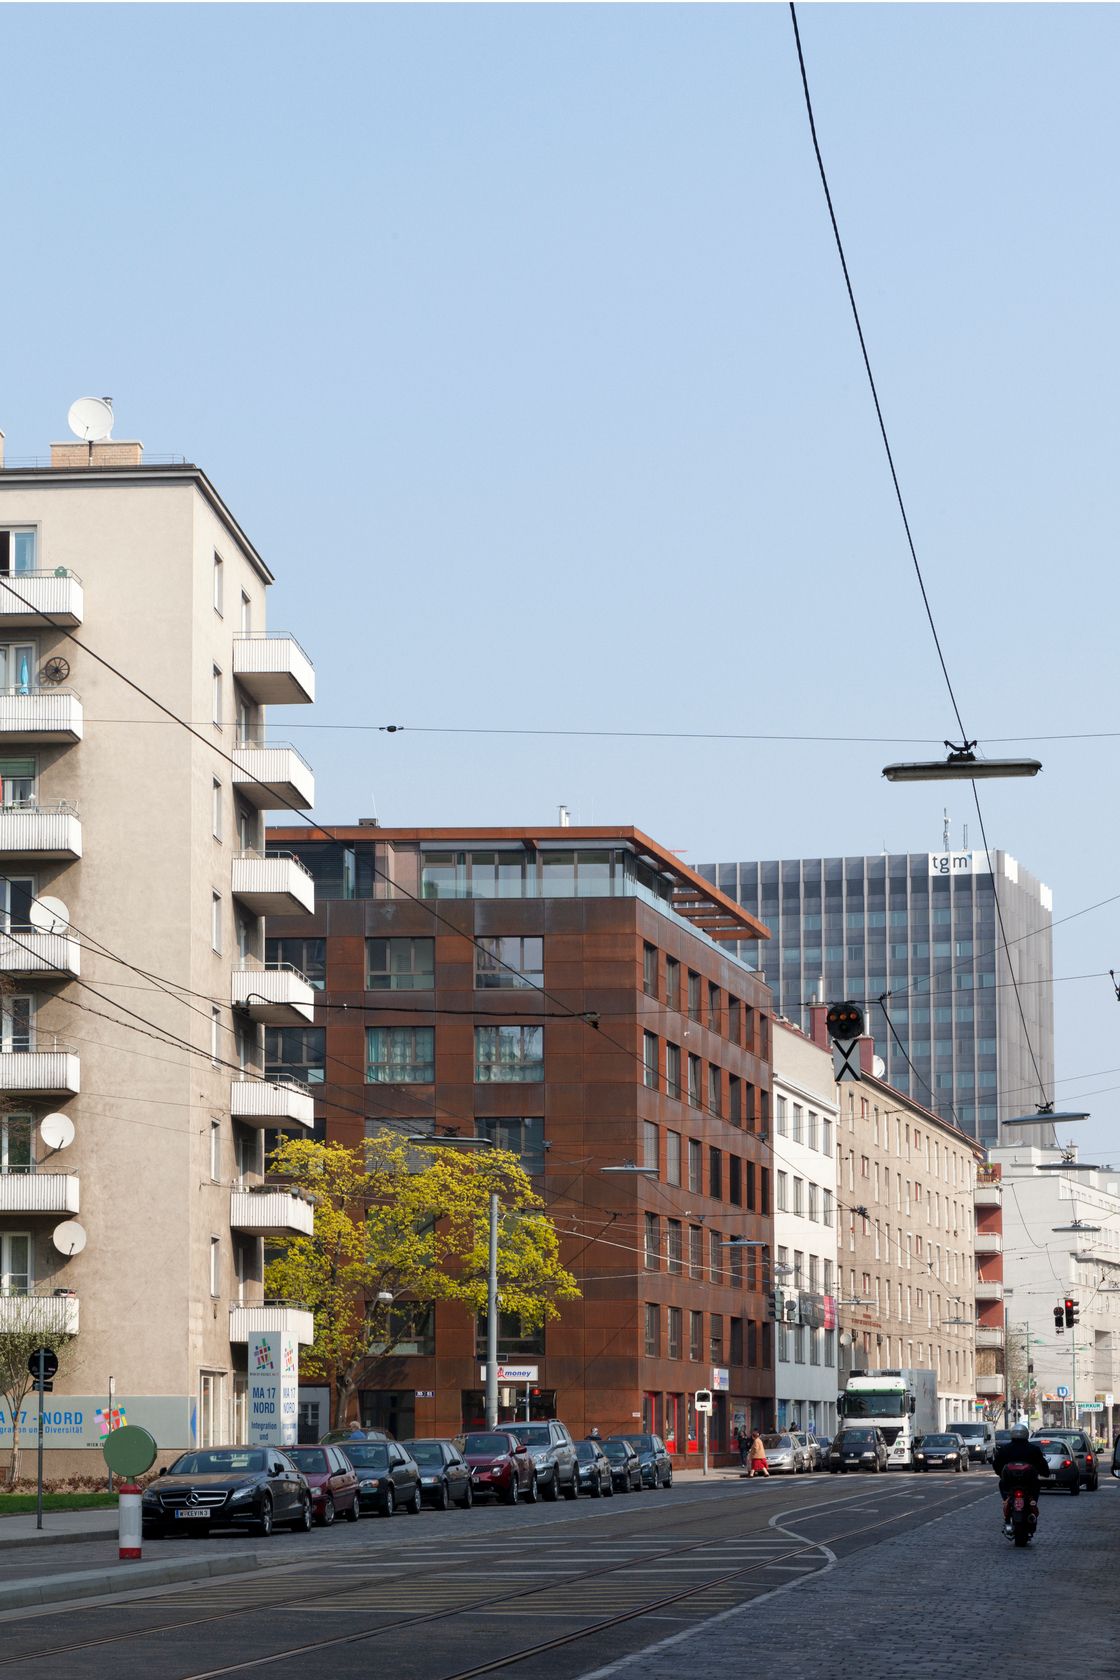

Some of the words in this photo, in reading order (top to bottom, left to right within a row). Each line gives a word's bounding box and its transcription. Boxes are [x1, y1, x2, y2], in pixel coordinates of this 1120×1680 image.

[932, 856, 967, 873] tgm
[253, 1387, 265, 1398] MA
[267, 1388, 276, 1398] 17
[254, 1402, 275, 1413] NORD
[43, 1412, 83, 1424] NORD
[251, 1422, 277, 1431] Integration
